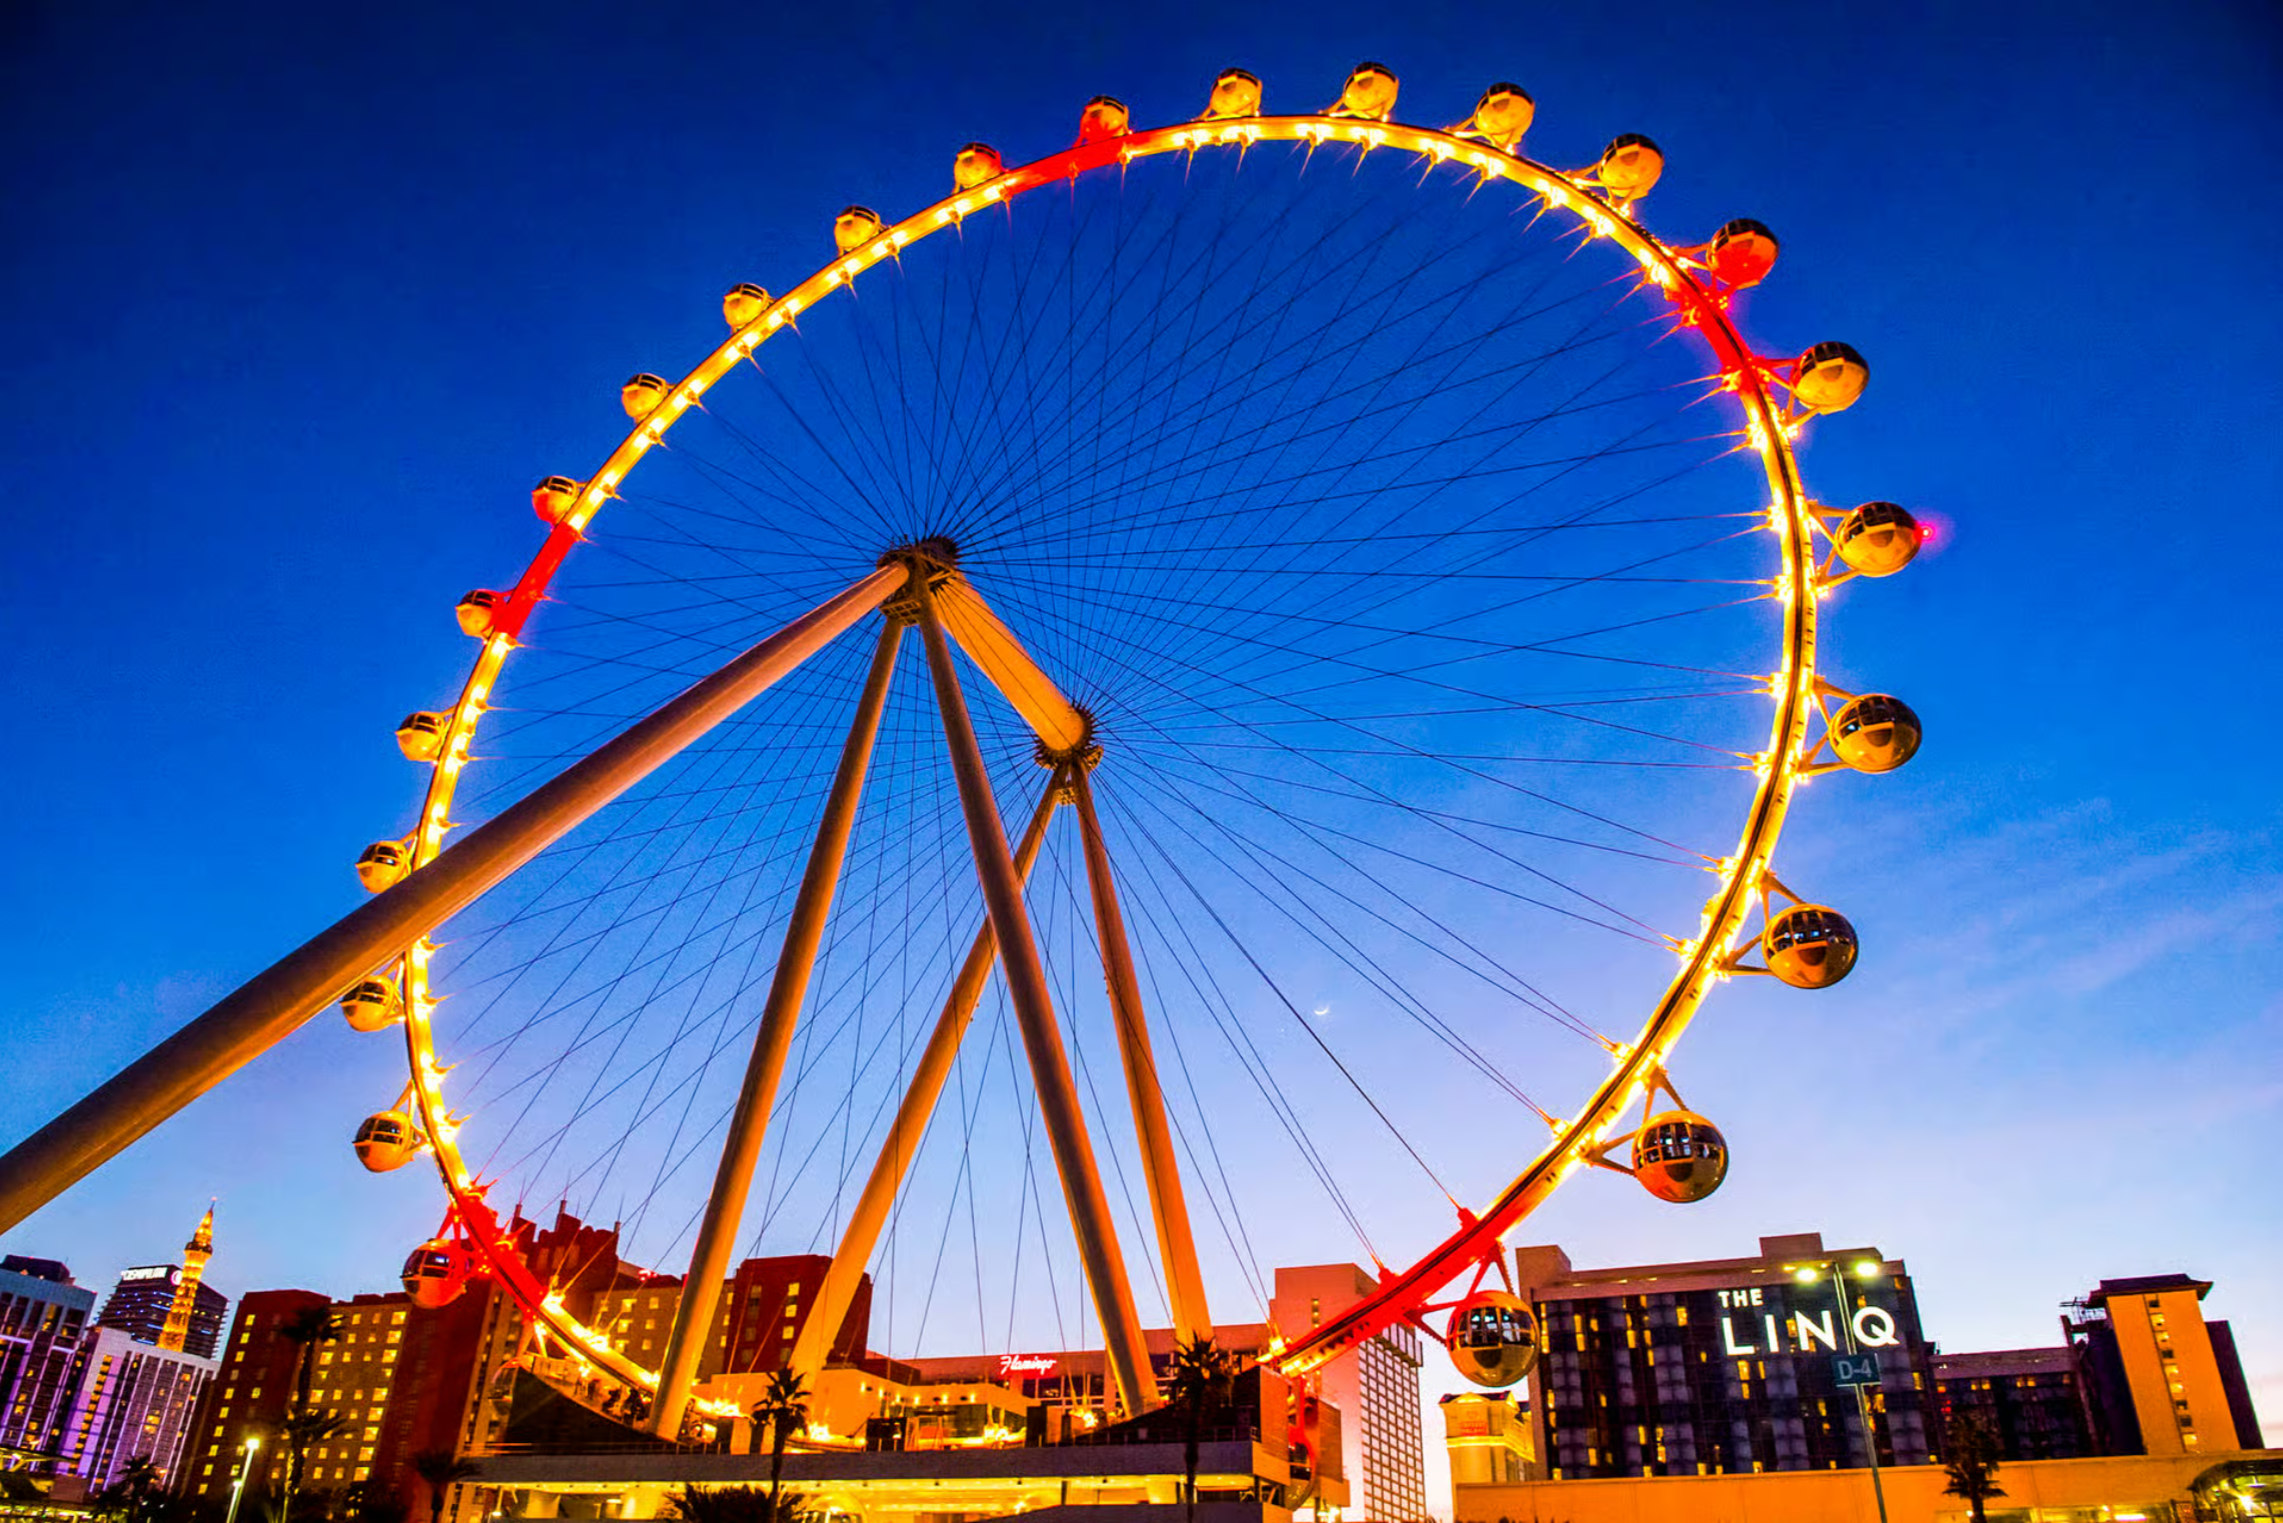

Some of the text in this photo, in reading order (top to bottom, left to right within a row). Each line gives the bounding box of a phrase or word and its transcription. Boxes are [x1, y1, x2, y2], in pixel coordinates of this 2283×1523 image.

[1717, 1288, 1764, 1308] THE
[1722, 1306, 1900, 1356] LINQ
[1000, 1355, 1057, 1375] Flamingo
[1838, 1358, 1873, 1380] D-4
